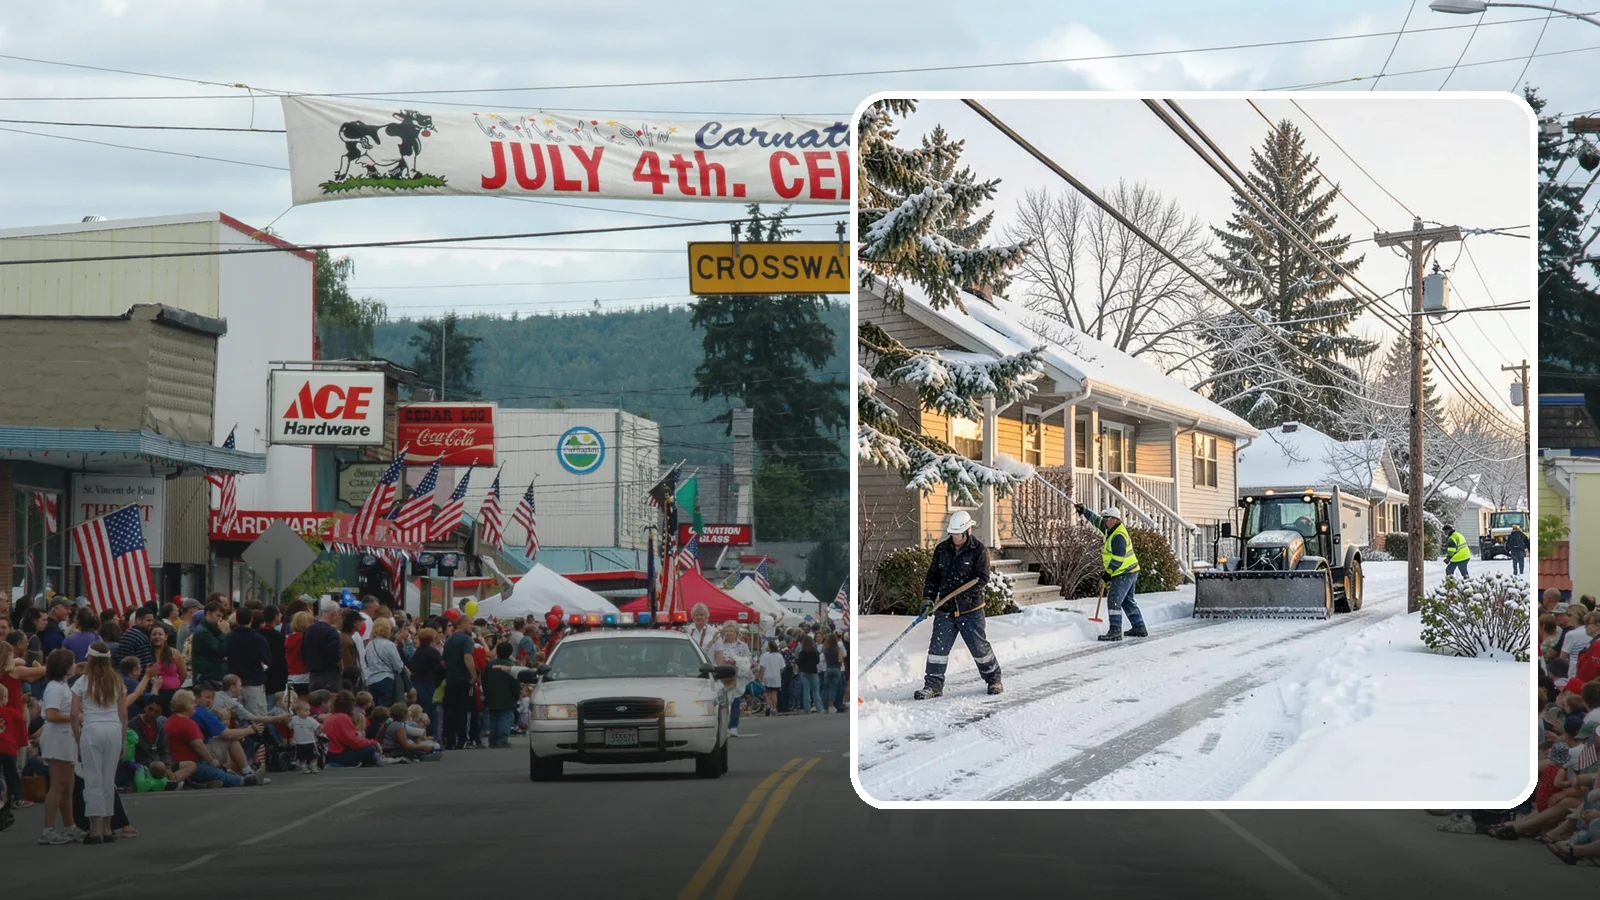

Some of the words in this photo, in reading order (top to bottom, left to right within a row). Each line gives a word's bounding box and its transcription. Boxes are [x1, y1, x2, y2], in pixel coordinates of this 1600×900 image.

[481, 141, 604, 192] JULY
[632, 150, 746, 197] 4th.
[696, 255, 849, 280] CROSSWA
[283, 380, 373, 420] ACE
[406, 409, 453, 422] CEDAR
[461, 409, 485, 422] LOG
[283, 421, 371, 436] Hardware
[416, 428, 477, 446] Coca-Cola
[83, 485, 94, 494] St.
[95, 485, 124, 495] Vincent
[126, 486, 135, 495] de
[137, 485, 155, 495] Paul
[212, 516, 331, 536] HARDARE
[688, 526, 741, 536] CRNATION
[699, 535, 730, 543] GLASS
